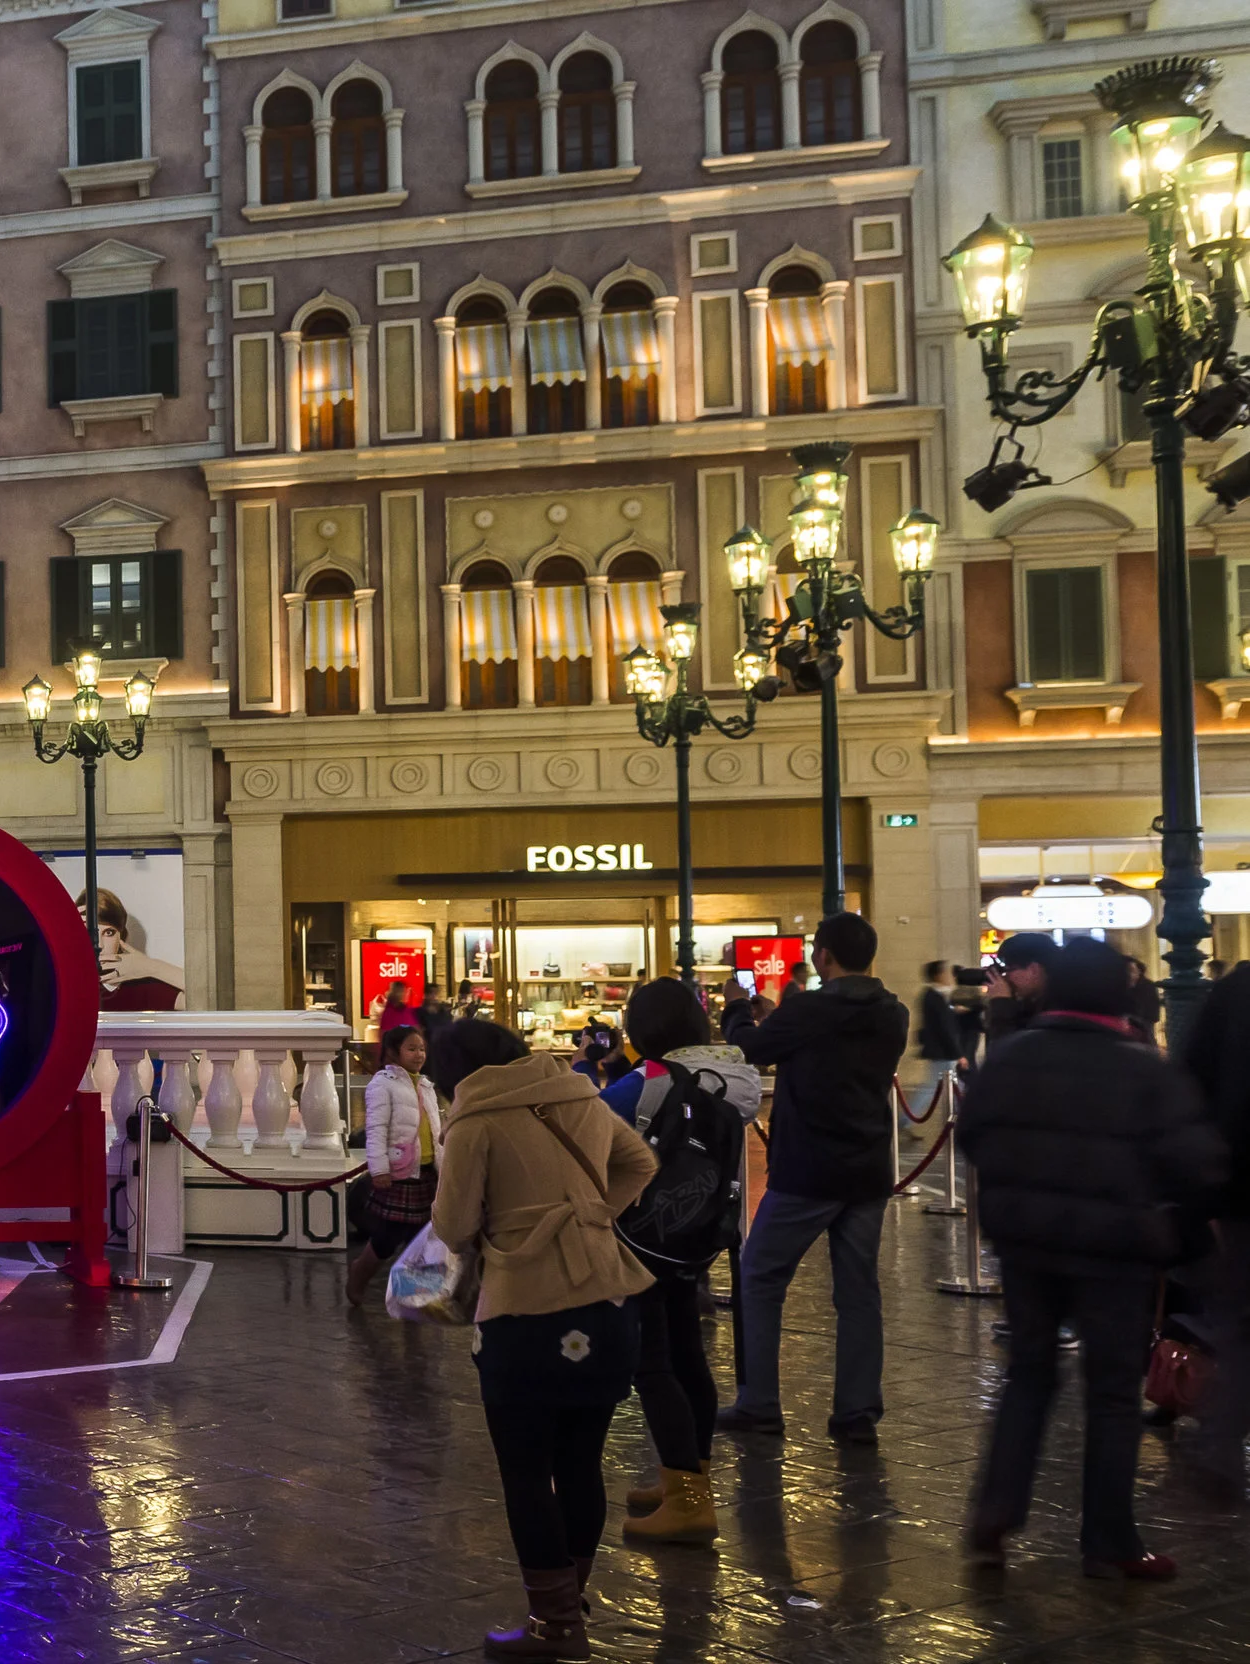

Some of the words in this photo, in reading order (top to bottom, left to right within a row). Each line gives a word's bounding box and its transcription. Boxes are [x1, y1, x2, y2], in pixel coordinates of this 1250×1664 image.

[527, 843, 653, 872] FOSSIL
[379, 956, 408, 978] sale
[753, 954, 786, 976] sale
